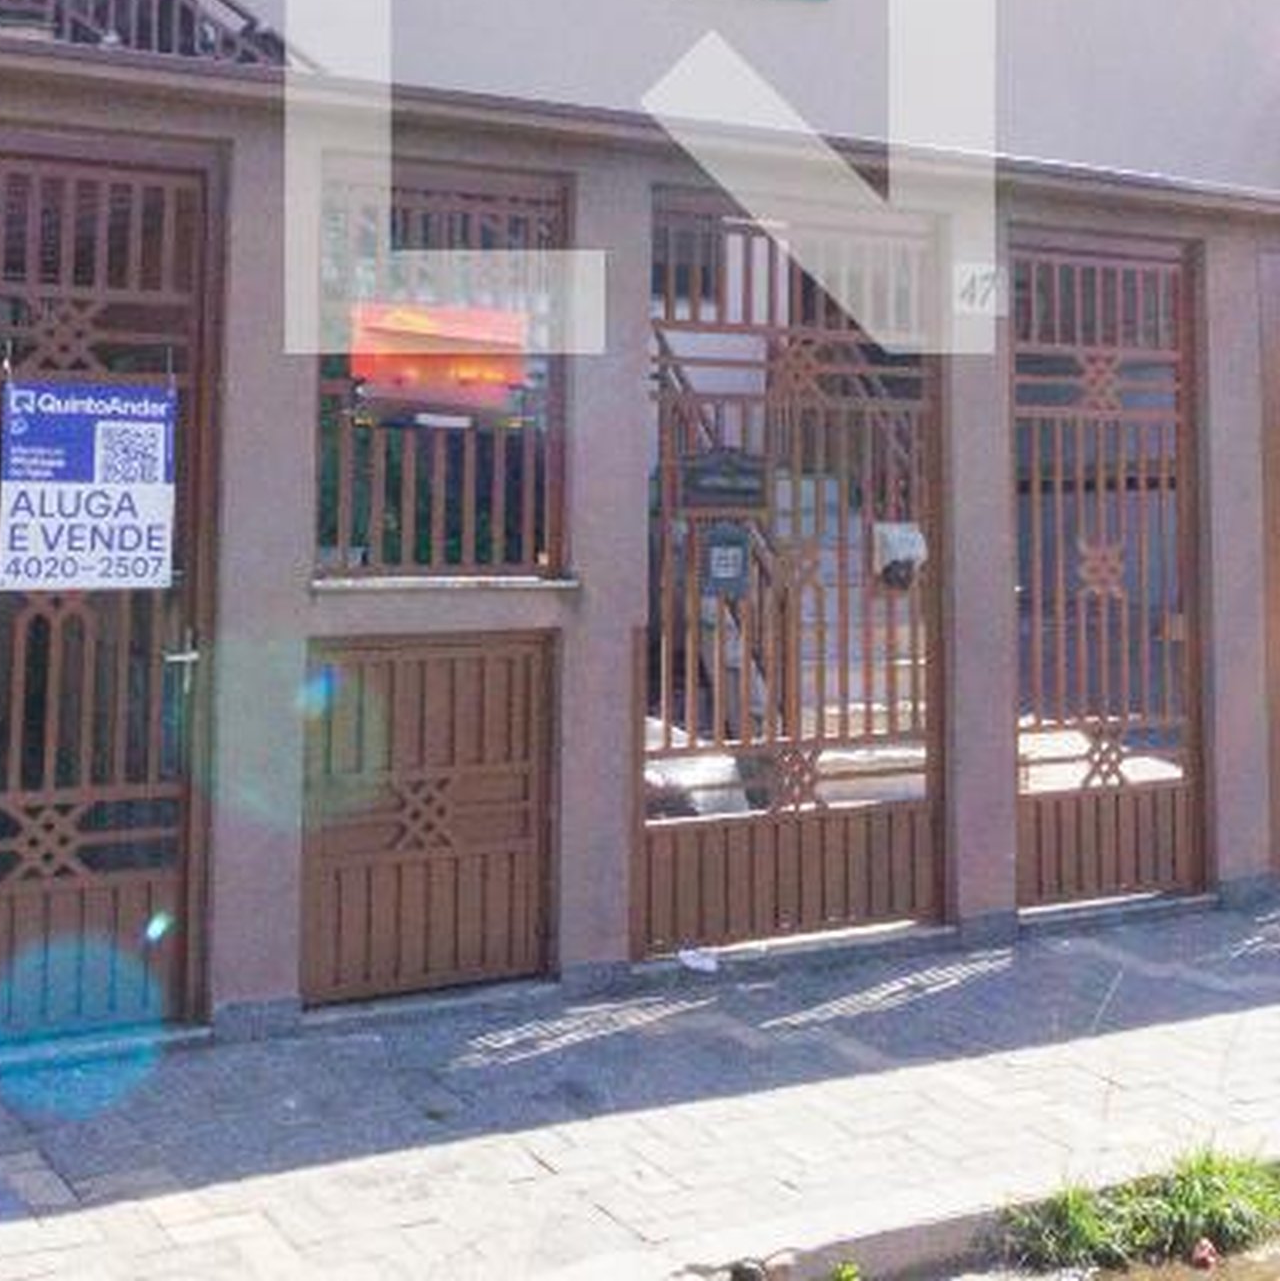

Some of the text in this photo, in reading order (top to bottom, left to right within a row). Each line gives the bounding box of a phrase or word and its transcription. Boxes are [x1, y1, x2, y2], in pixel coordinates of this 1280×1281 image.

[10, 490, 138, 519] ALUGA
[9, 523, 165, 553] E VENDE
[4, 555, 164, 579] 4020-2507
